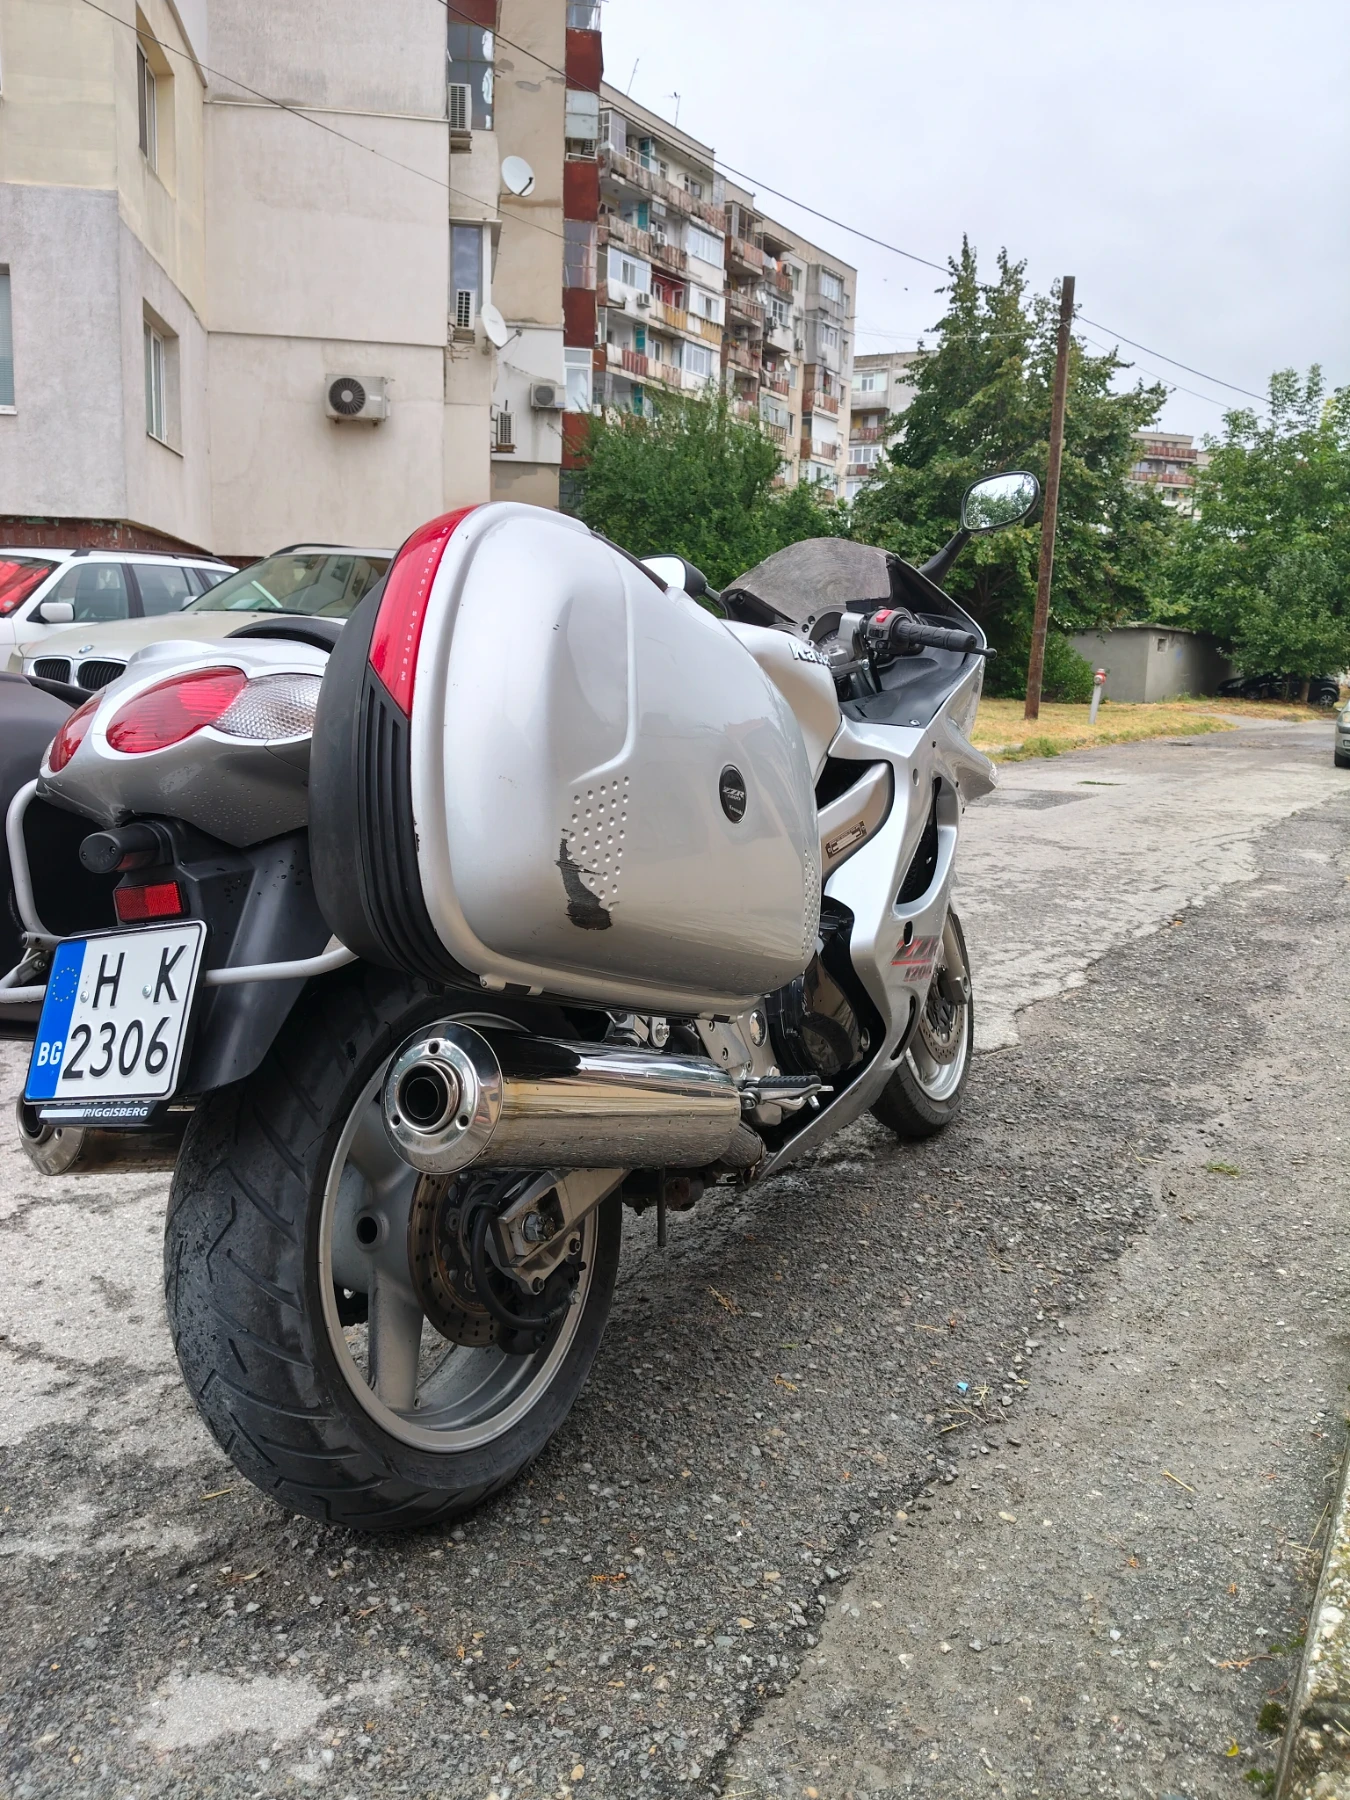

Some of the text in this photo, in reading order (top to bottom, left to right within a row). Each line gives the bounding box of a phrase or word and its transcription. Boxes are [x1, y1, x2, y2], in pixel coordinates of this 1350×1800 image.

[401, 610, 417, 681] SYSTEM
[37, 1041, 63, 1067] BG
[62, 1016, 171, 1080] 2306
[83, 1107, 149, 1118] RIGGISBERG
